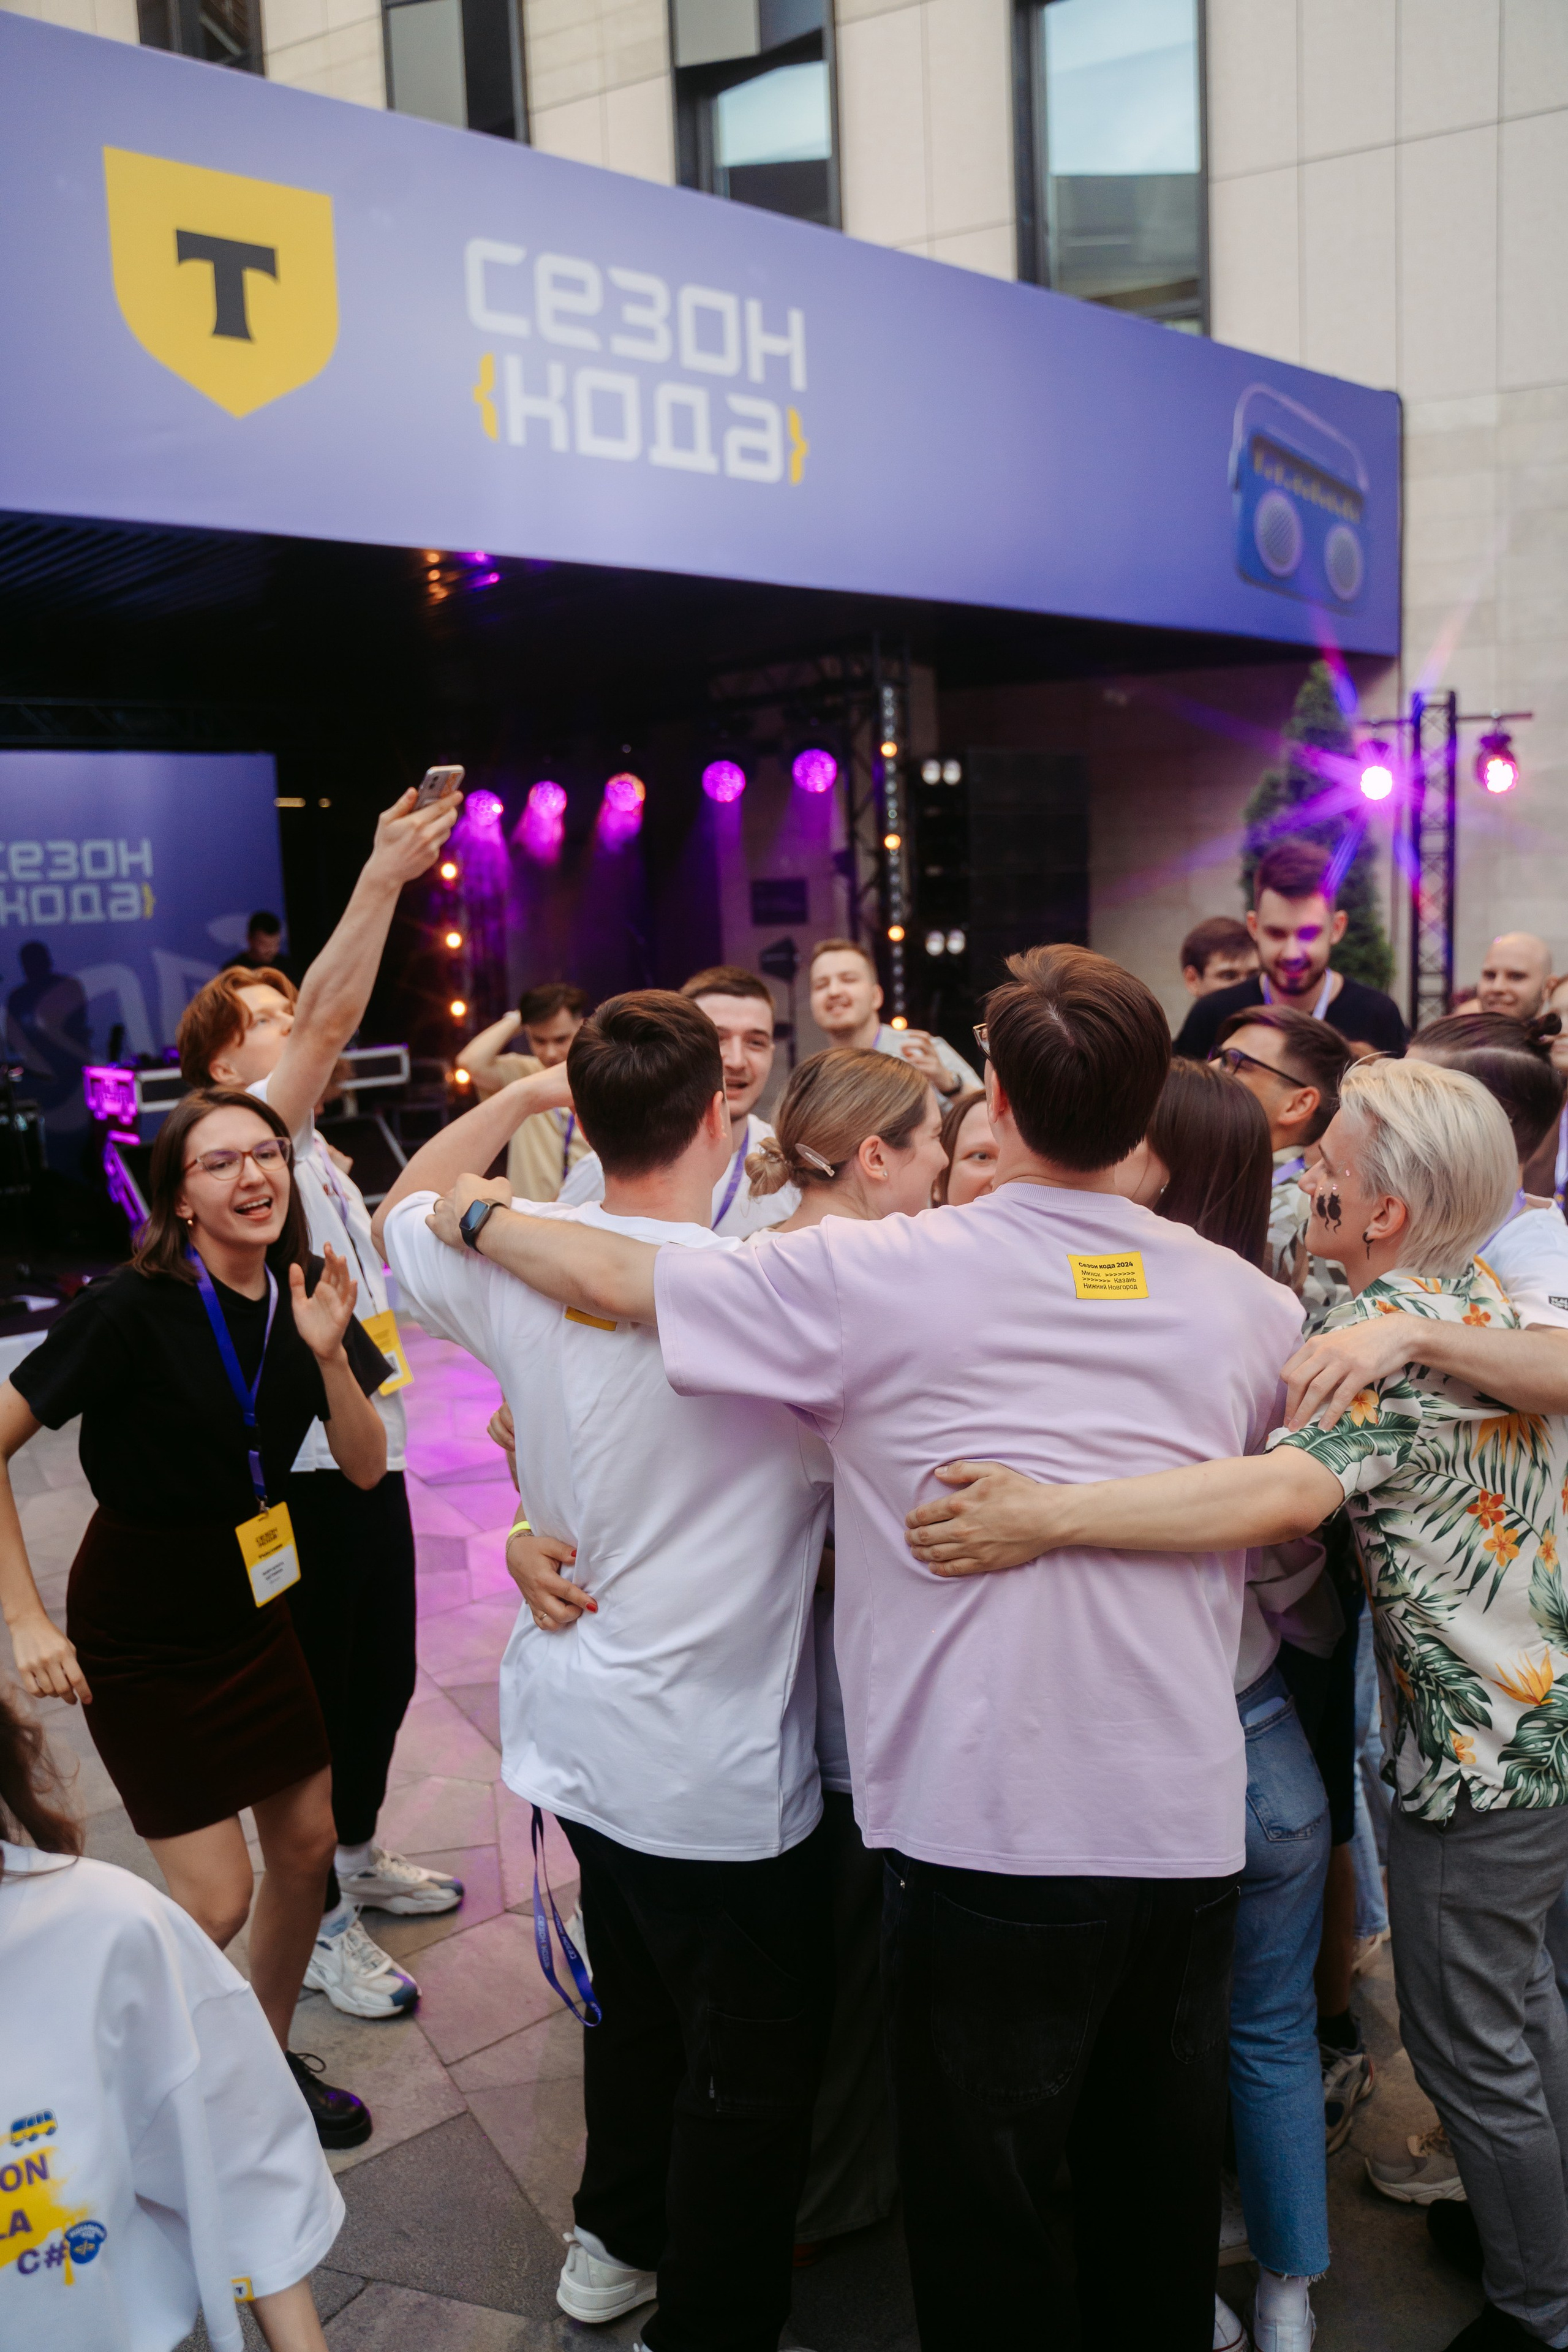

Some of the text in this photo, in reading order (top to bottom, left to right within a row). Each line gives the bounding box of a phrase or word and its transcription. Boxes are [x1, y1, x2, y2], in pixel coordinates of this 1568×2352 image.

[0, 839, 153, 882] езон
[0, 2153, 50, 2193] ON
[0, 2209, 33, 2241] A
[17, 2241, 67, 2275] C#
